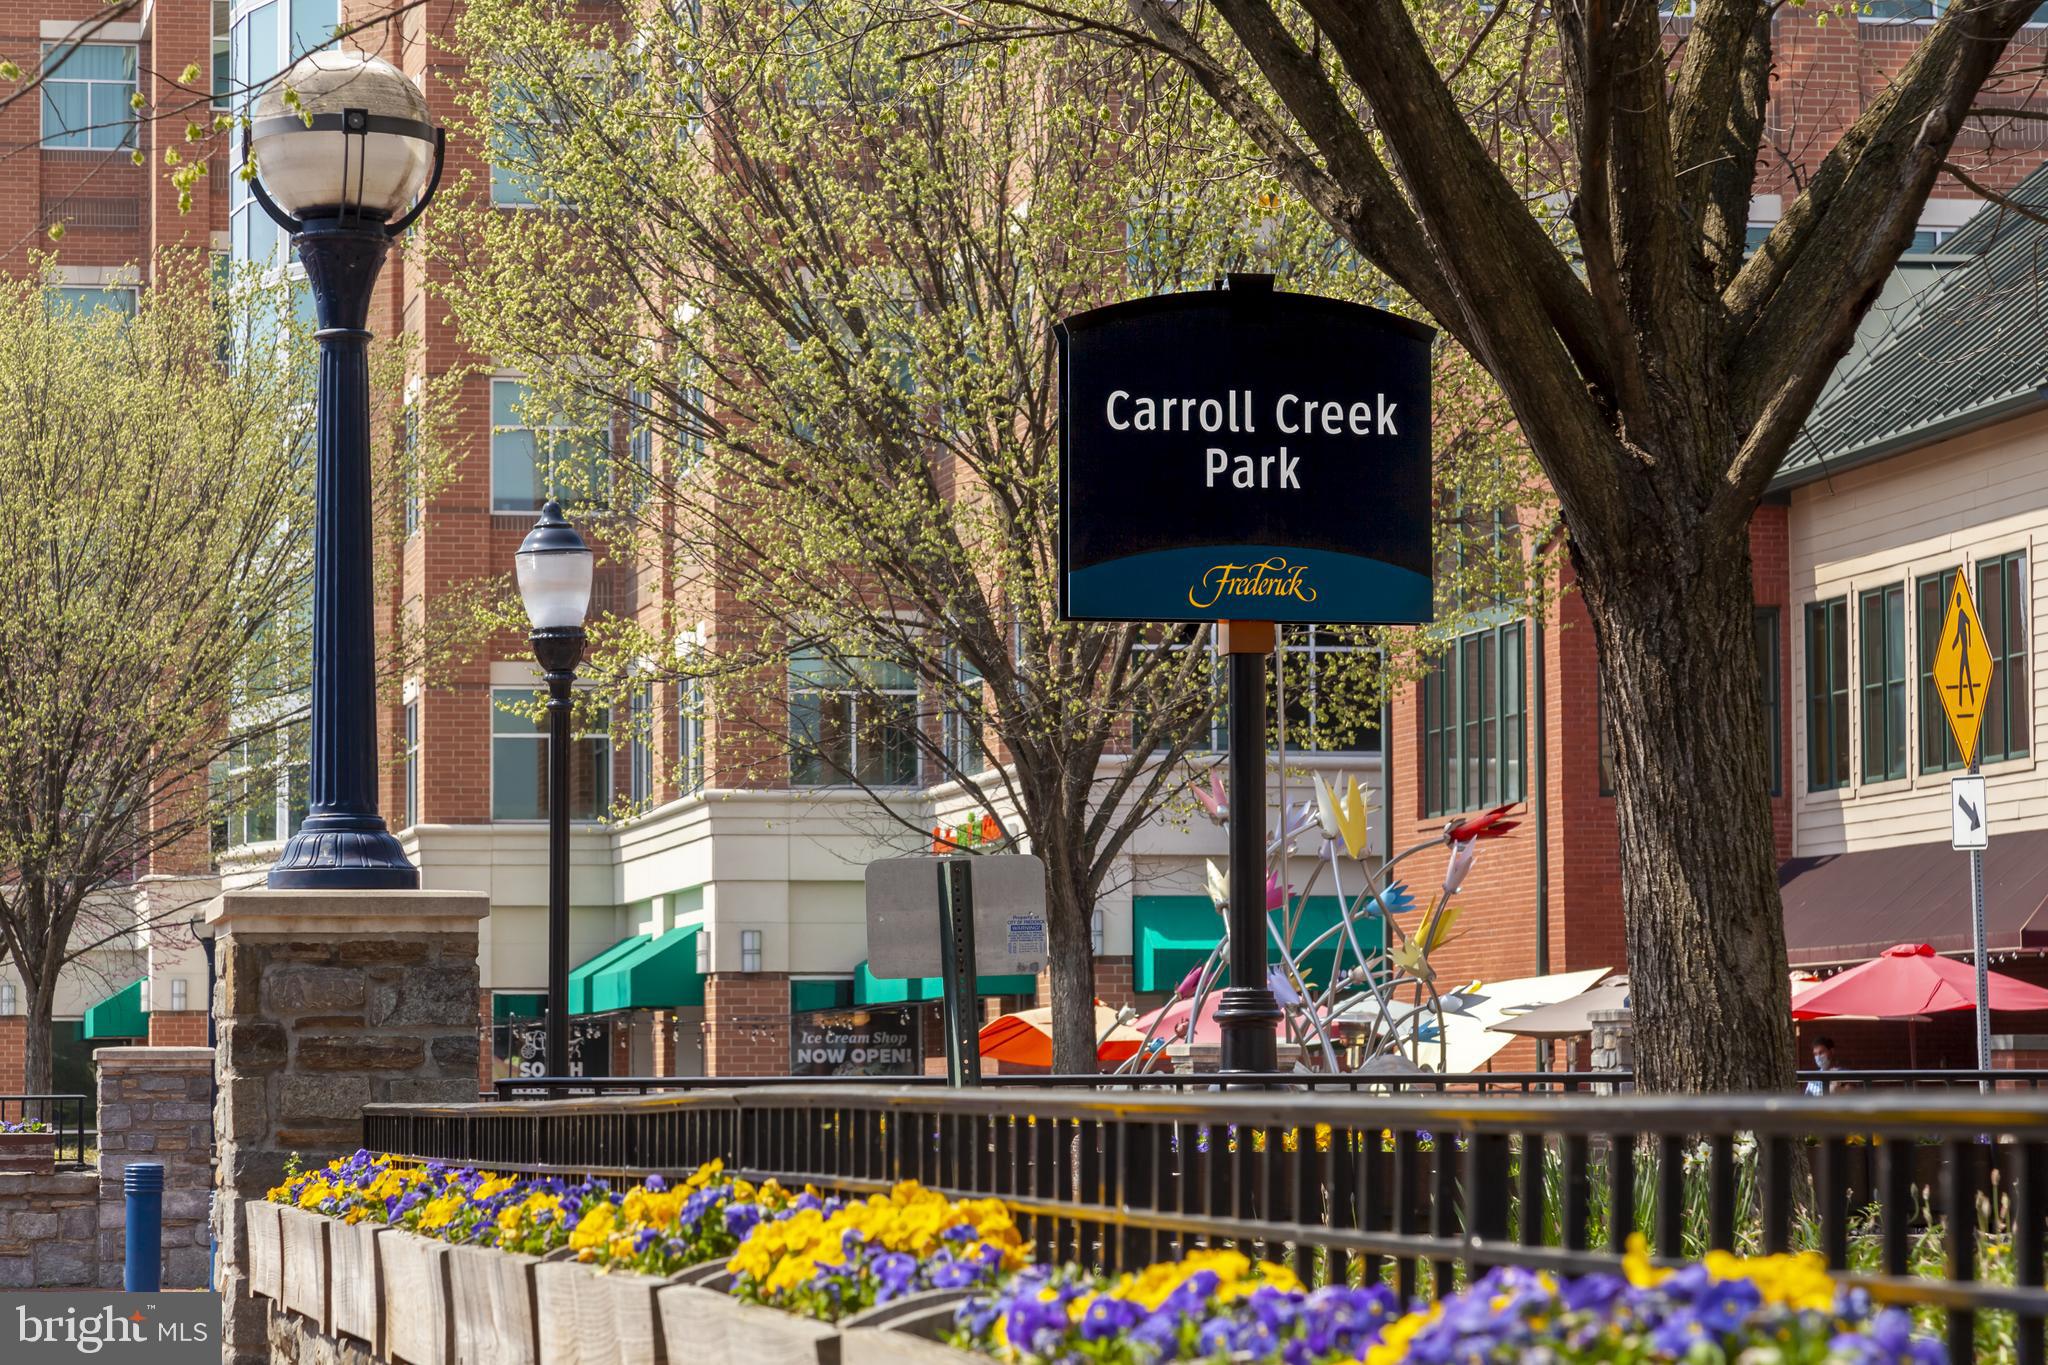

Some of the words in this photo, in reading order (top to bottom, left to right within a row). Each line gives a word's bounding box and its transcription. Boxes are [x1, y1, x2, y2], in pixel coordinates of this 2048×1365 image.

[1106, 389, 1255, 432] Carroll
[1276, 393, 1398, 435] Creek
[1206, 446, 1300, 489] Park
[1188, 556, 1317, 608] Frederick
[802, 1032, 822, 1044] Ice
[825, 1033, 869, 1044] Cream
[873, 1031, 907, 1046] Shop
[520, 1061, 584, 1078] SOH
[798, 1049, 846, 1063] NOW
[851, 1048, 911, 1063] OPEN!
